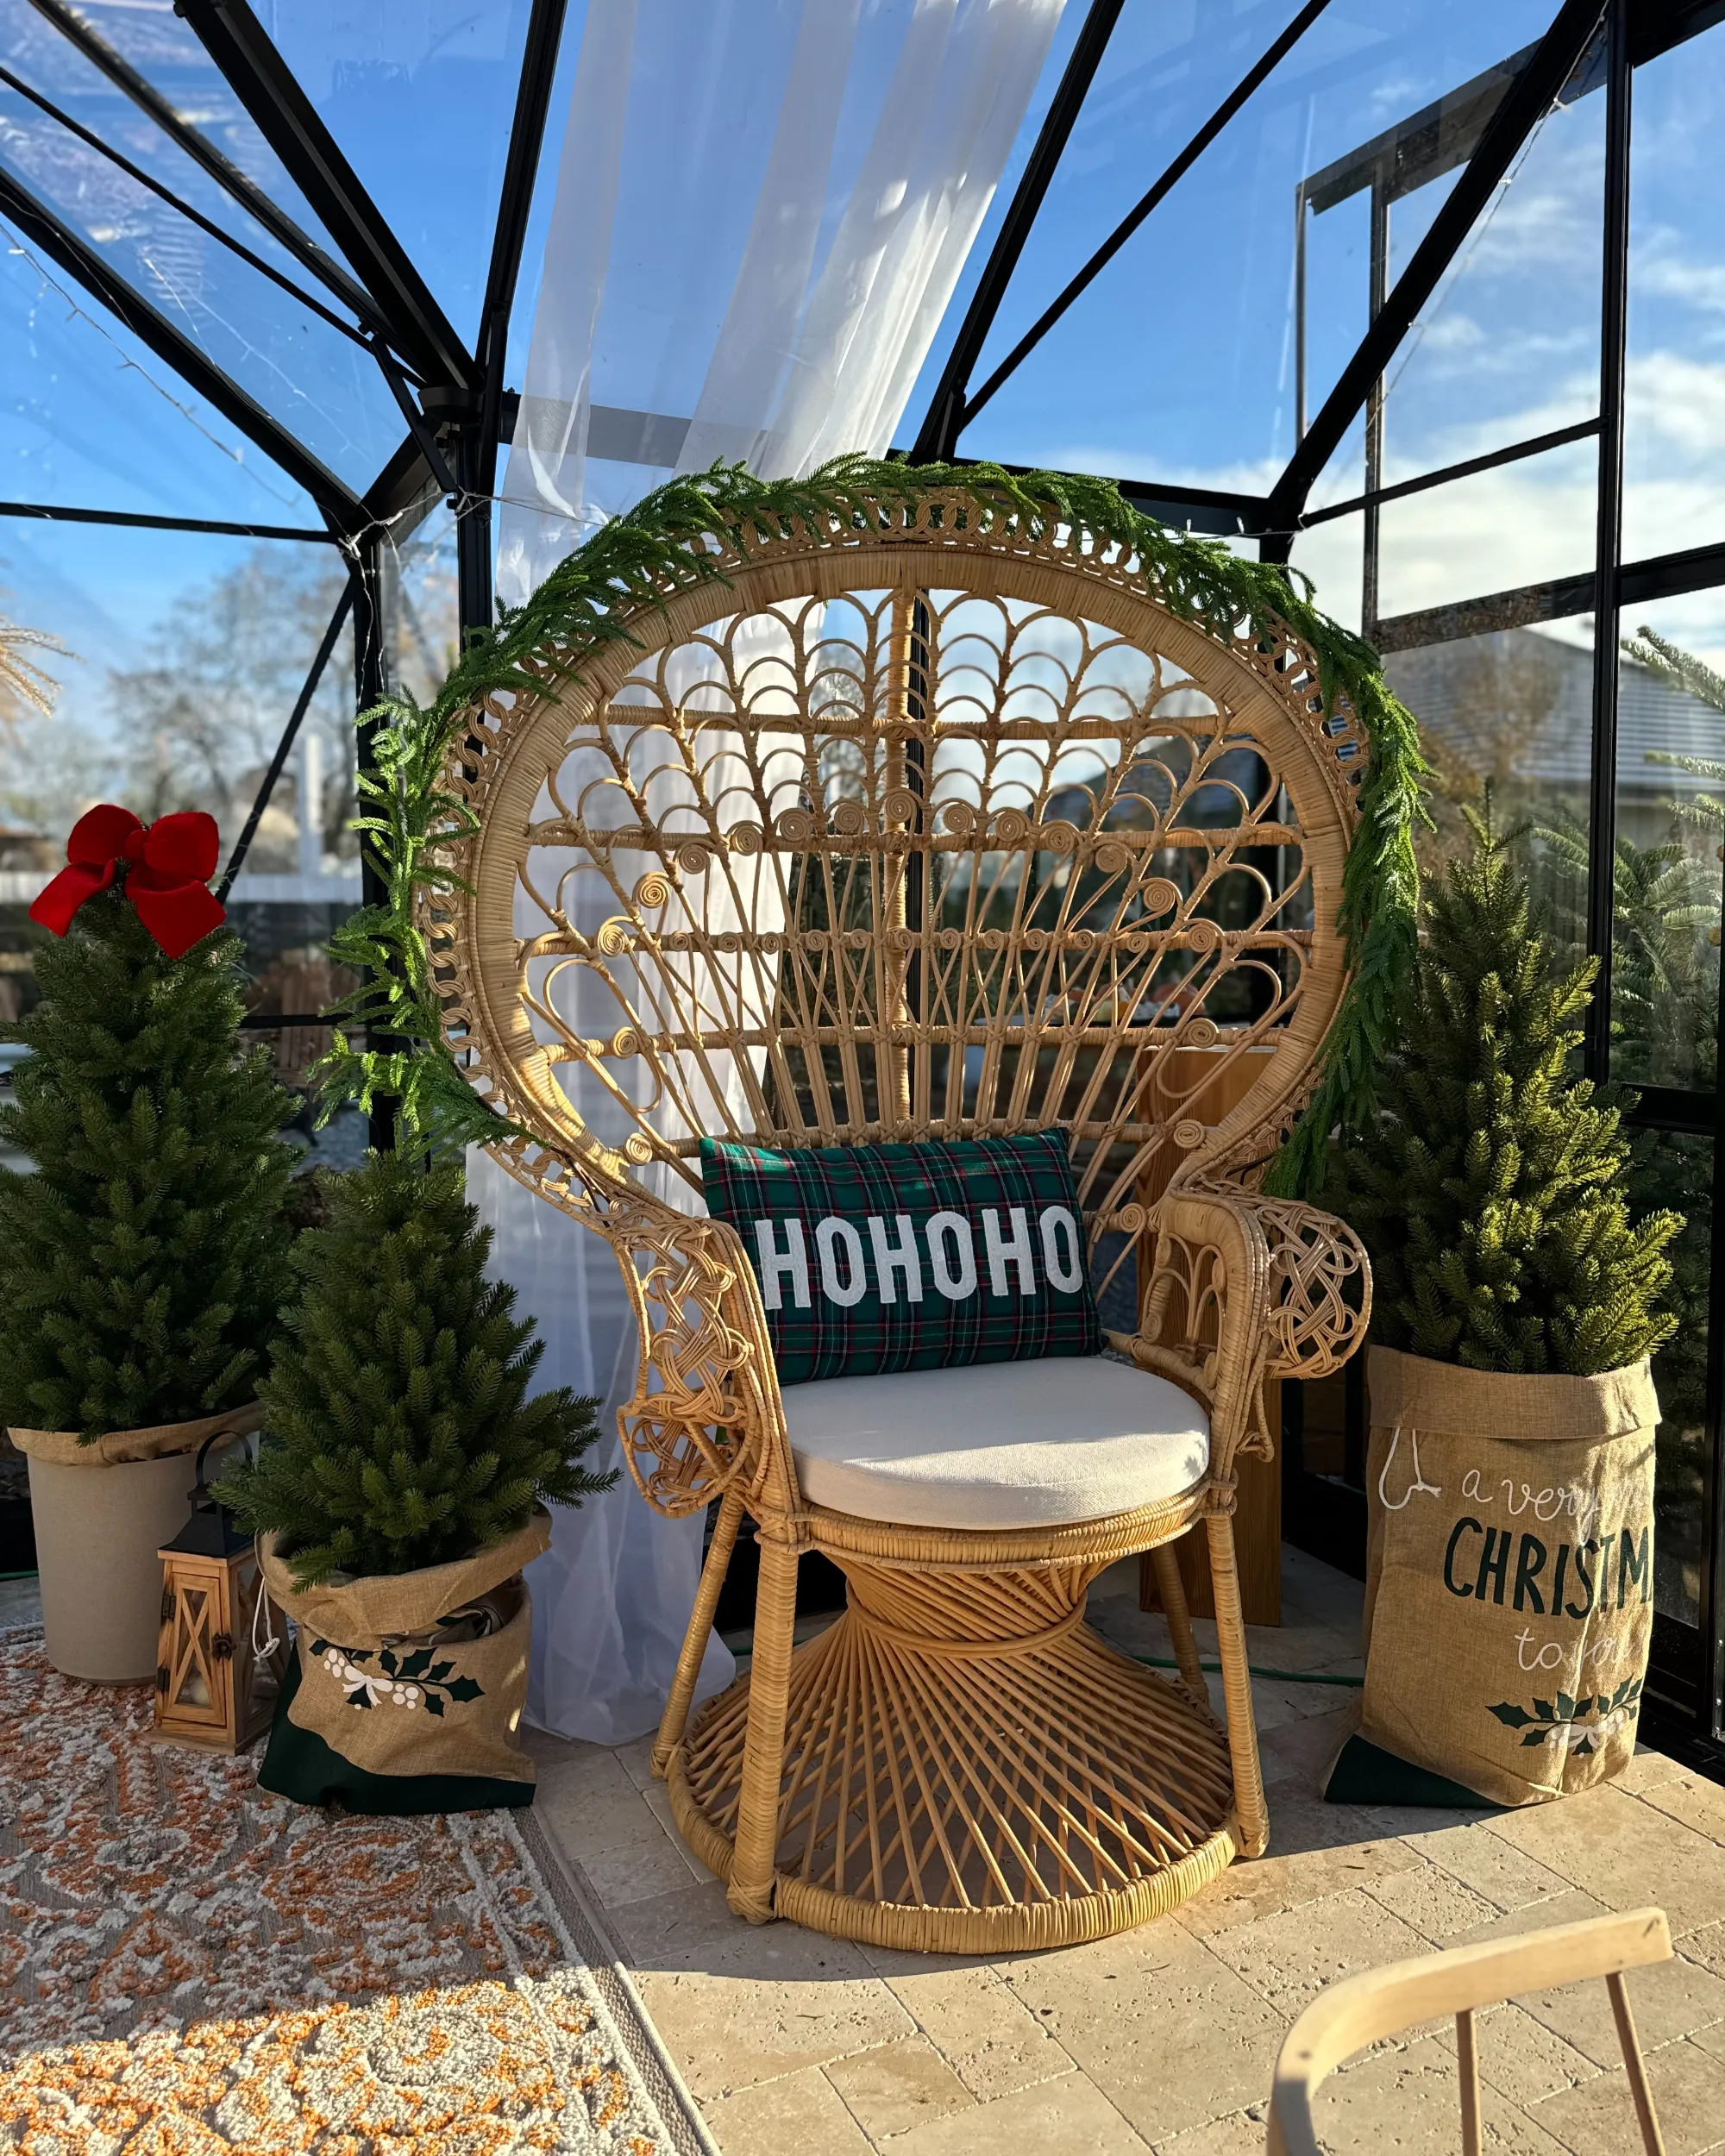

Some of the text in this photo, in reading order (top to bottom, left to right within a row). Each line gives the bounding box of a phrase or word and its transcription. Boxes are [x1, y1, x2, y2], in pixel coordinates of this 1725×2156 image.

[755, 1206, 1083, 1310] HOHOHO
[1462, 1470, 1494, 1502] a
[1501, 1479, 1599, 1546] very
[1444, 1517, 1652, 1620] CHRISTM
[1515, 1627, 1563, 1671] to
